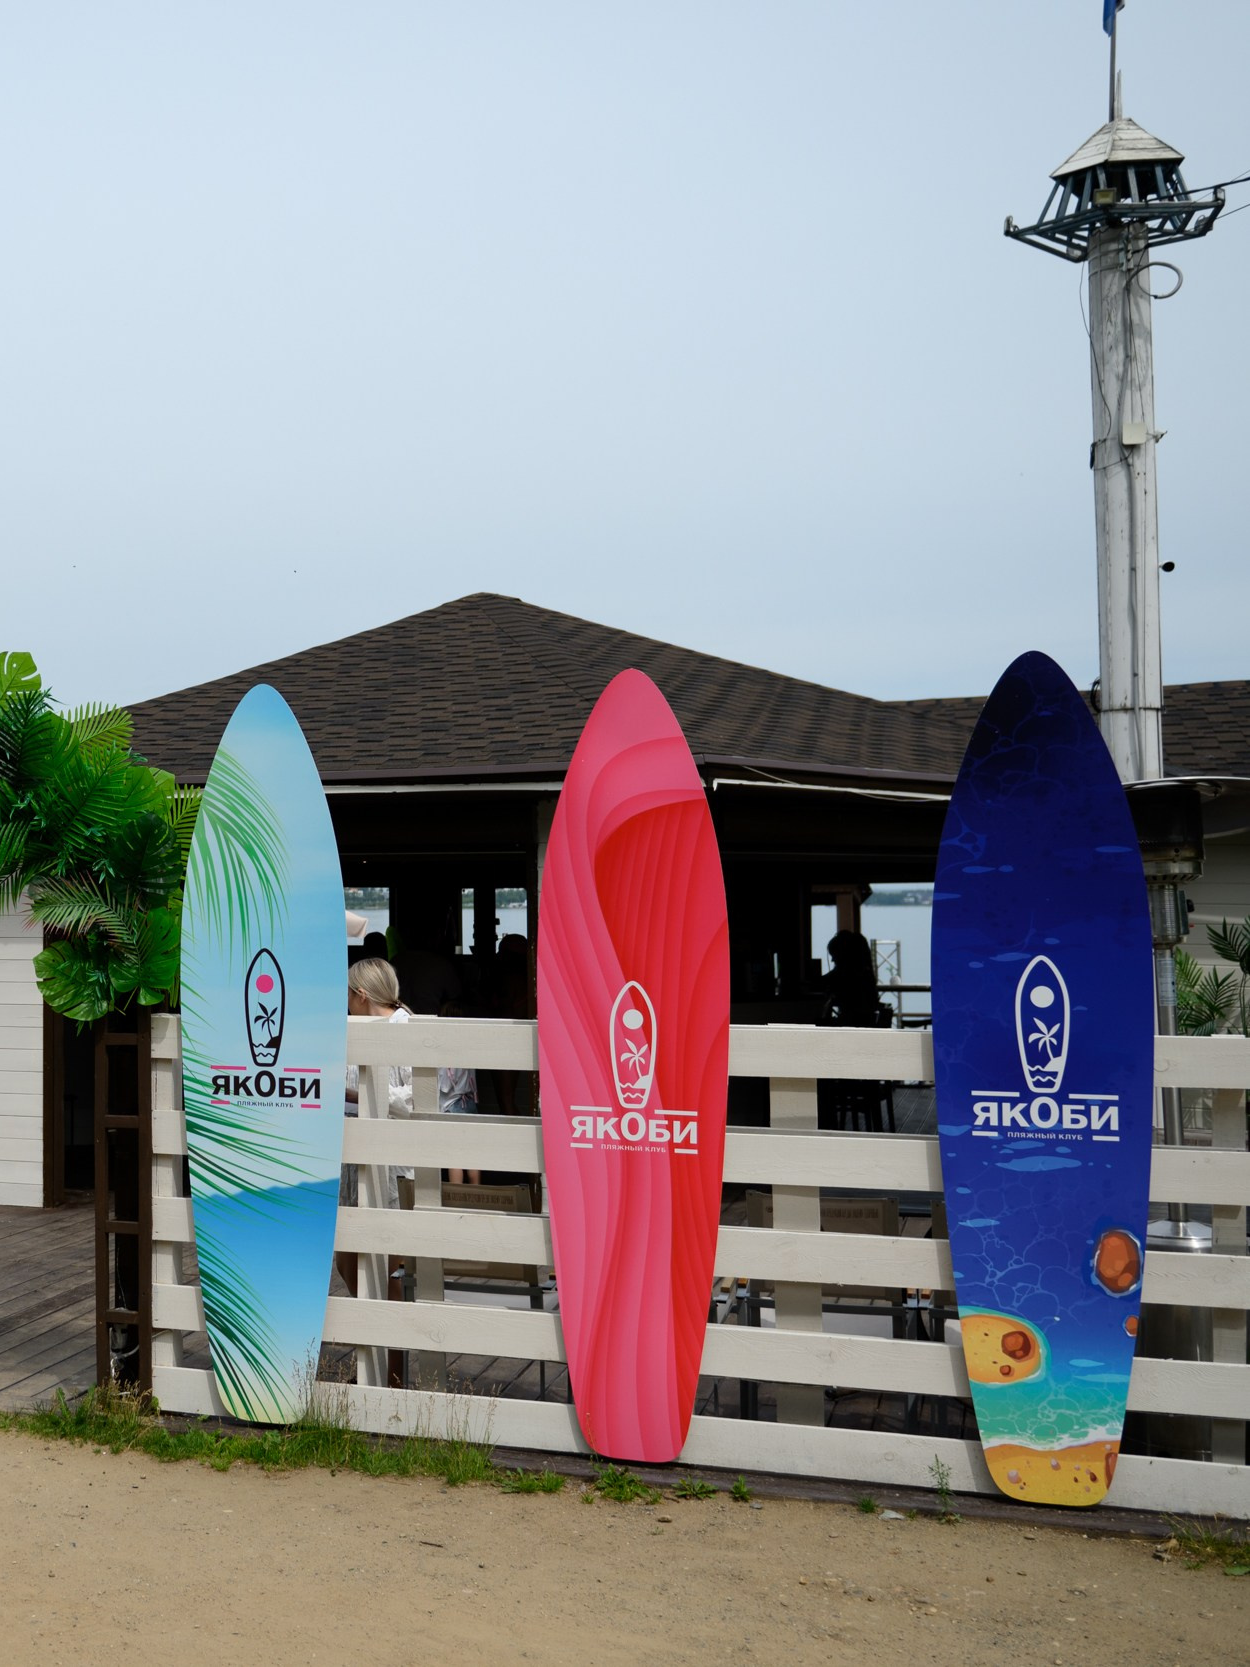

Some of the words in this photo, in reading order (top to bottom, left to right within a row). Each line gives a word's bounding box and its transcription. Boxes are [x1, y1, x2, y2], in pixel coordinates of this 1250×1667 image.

[211, 1070, 321, 1099] ЯКОБИ
[237, 1100, 274, 1108] ПЛЯЖНЫЙ
[972, 1096, 1119, 1131] ЯКОБИ
[571, 1111, 698, 1144] ЯКОБИ
[1007, 1131, 1056, 1140] ПЛЯЖНЫЙ
[601, 1143, 643, 1152] ПЛЯЖНЫЙ
